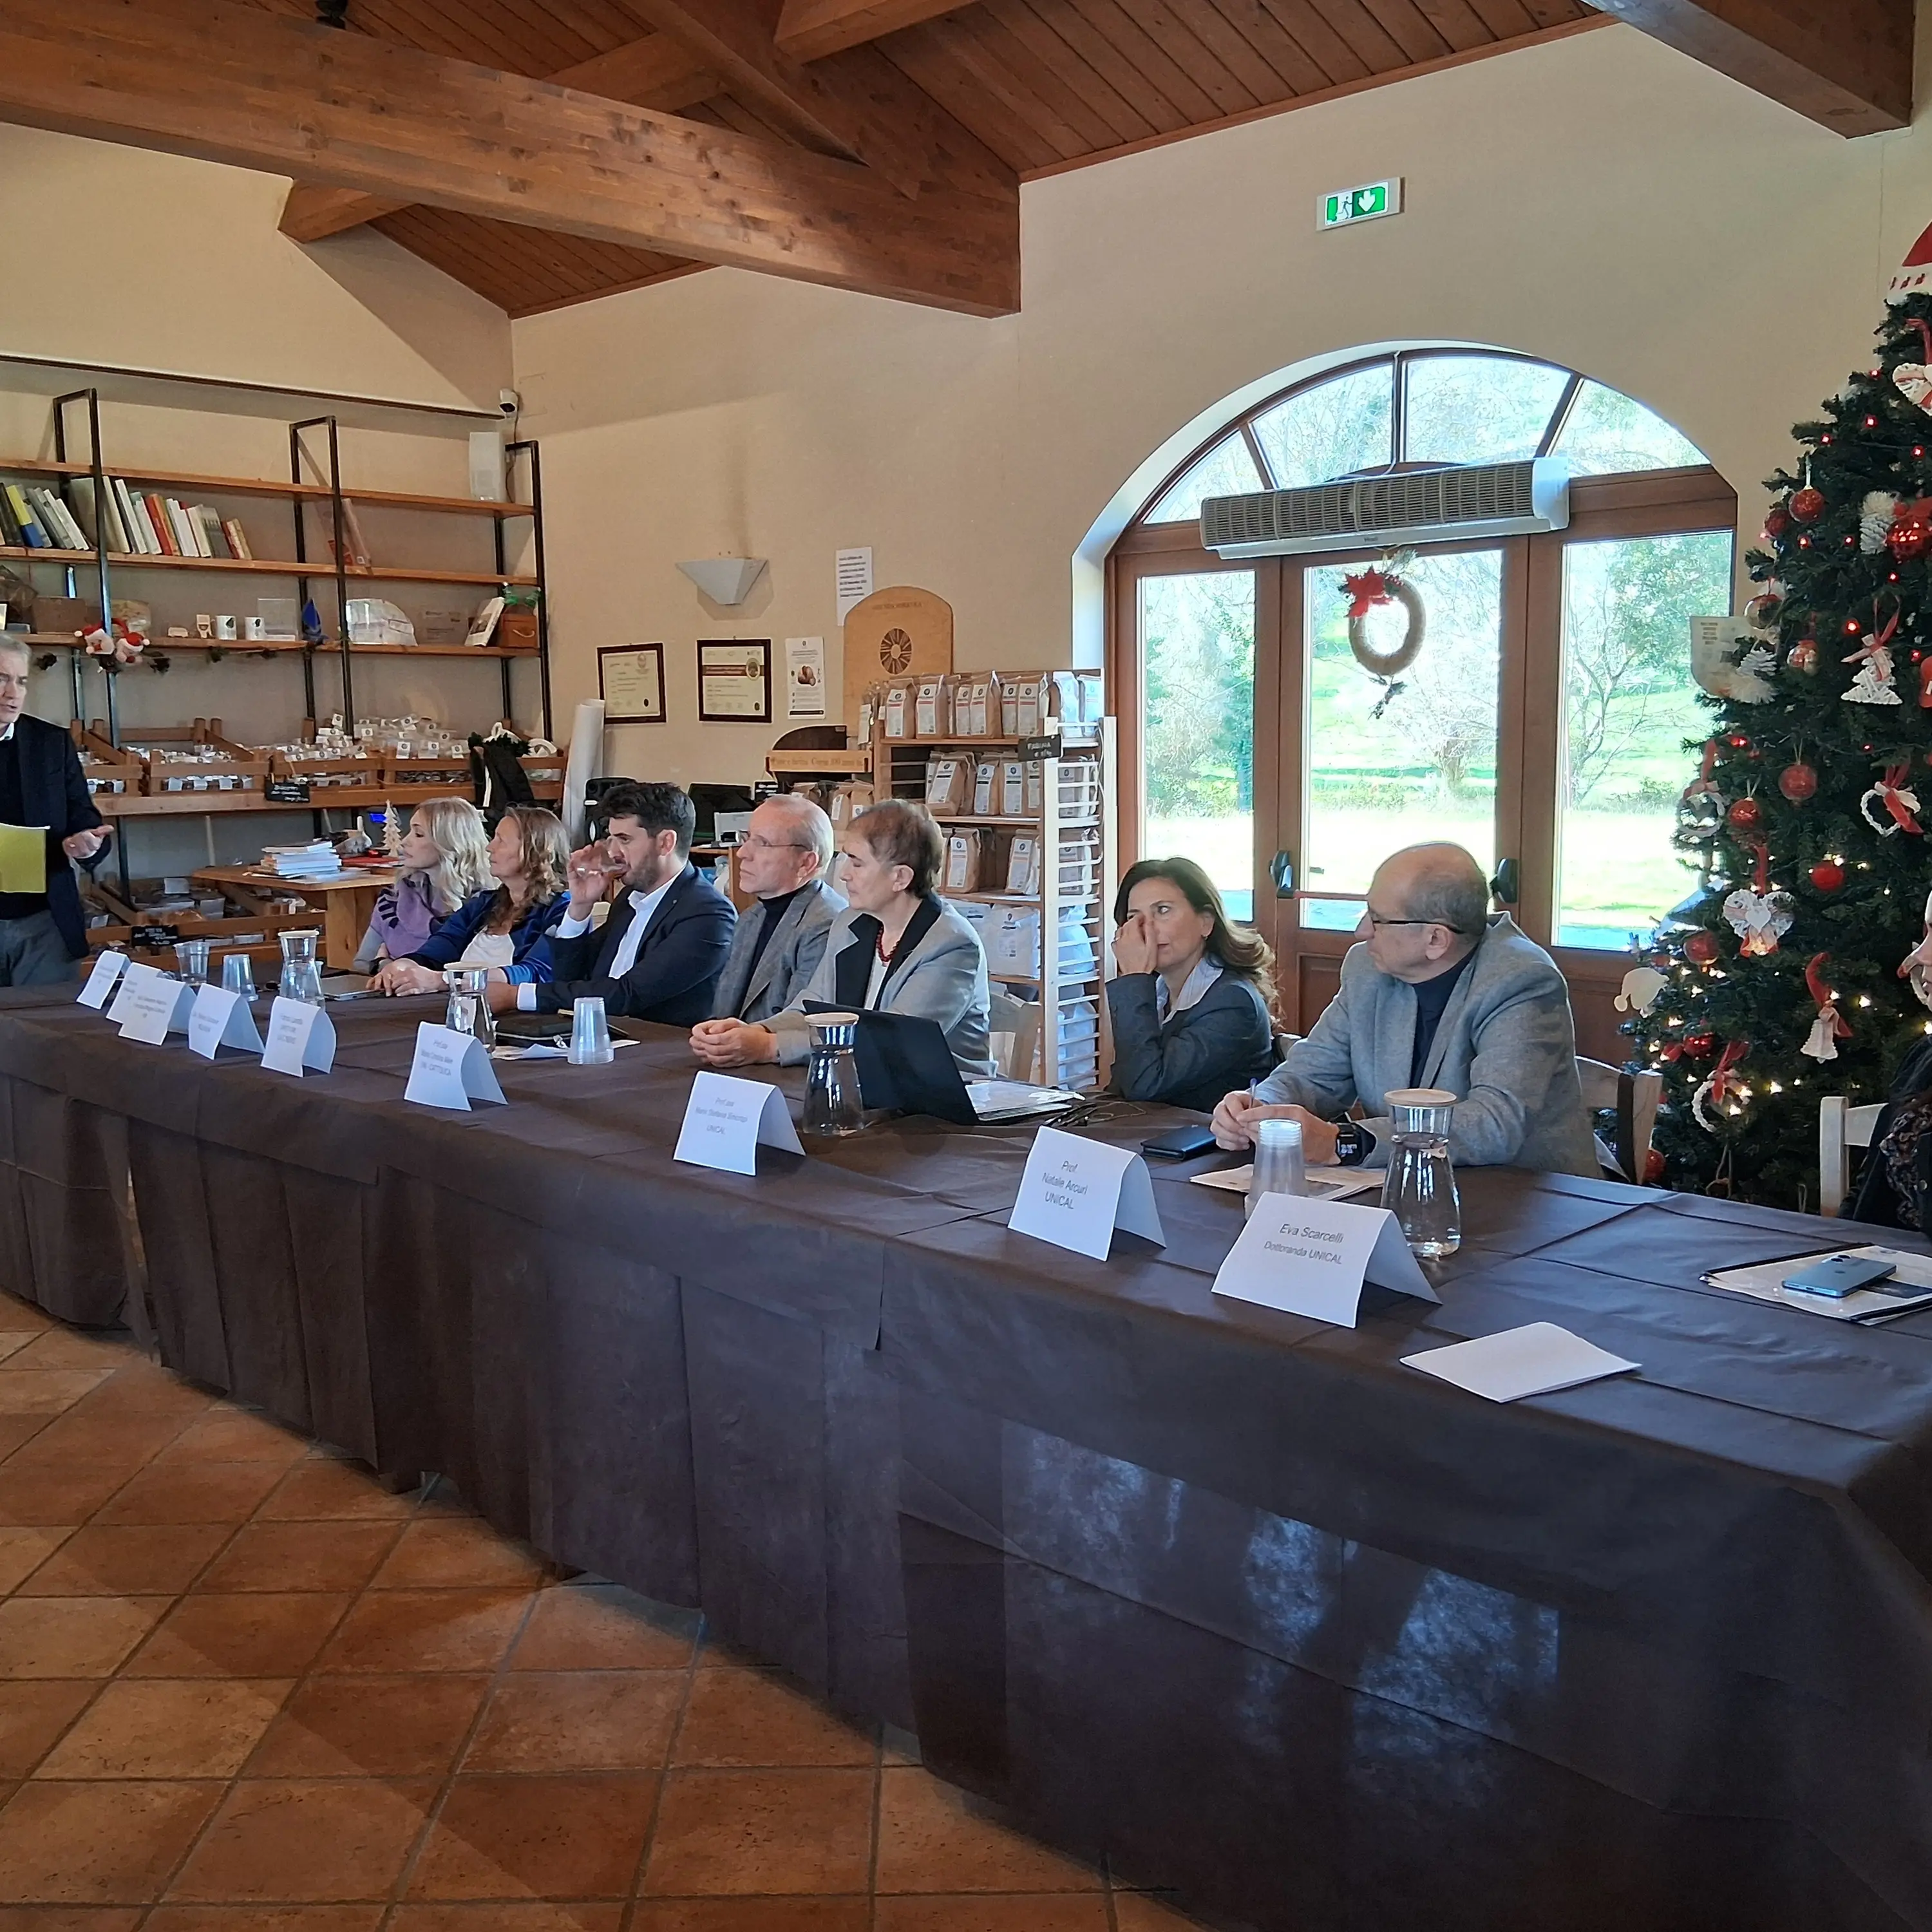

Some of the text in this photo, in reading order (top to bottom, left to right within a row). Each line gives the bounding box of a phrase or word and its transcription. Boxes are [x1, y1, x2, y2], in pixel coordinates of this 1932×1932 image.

[1065, 1180, 1088, 1195] Arcuri
[1045, 1191, 1074, 1209] UNICAL
[1280, 1224, 1345, 1244] Eva Scarcelli
[1264, 1240, 1342, 1265] Dottoranda UNICAL
